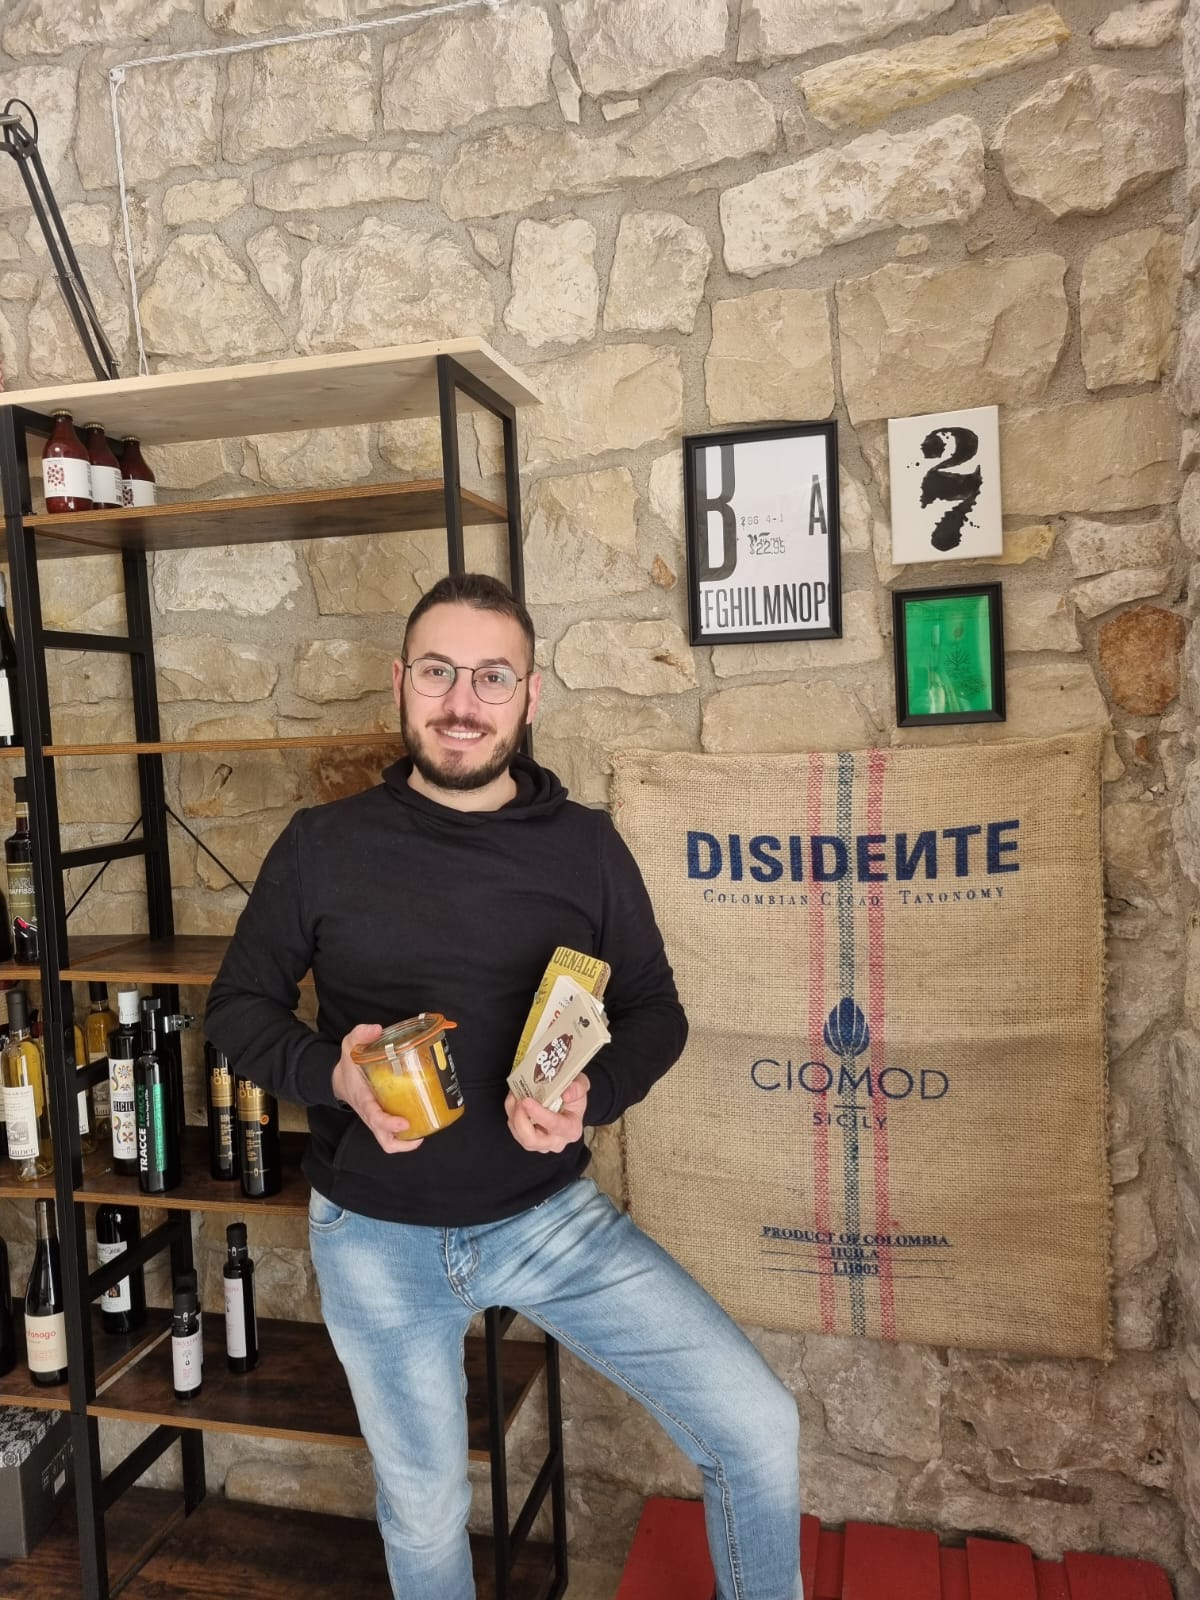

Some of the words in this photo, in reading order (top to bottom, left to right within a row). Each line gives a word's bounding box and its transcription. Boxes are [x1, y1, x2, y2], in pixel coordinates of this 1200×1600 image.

[808, 473, 828, 536] A
[899, 886, 1006, 906] TAXONOMY
[751, 1058, 949, 1100] CIOMOD
[812, 1111, 888, 1130] SICILY
[138, 1127, 149, 1172] TRACCE
[762, 1225, 835, 1245] PRODUCT
[839, 1232, 859, 1245] OF
[862, 1233, 949, 1247] COLOMBIA
